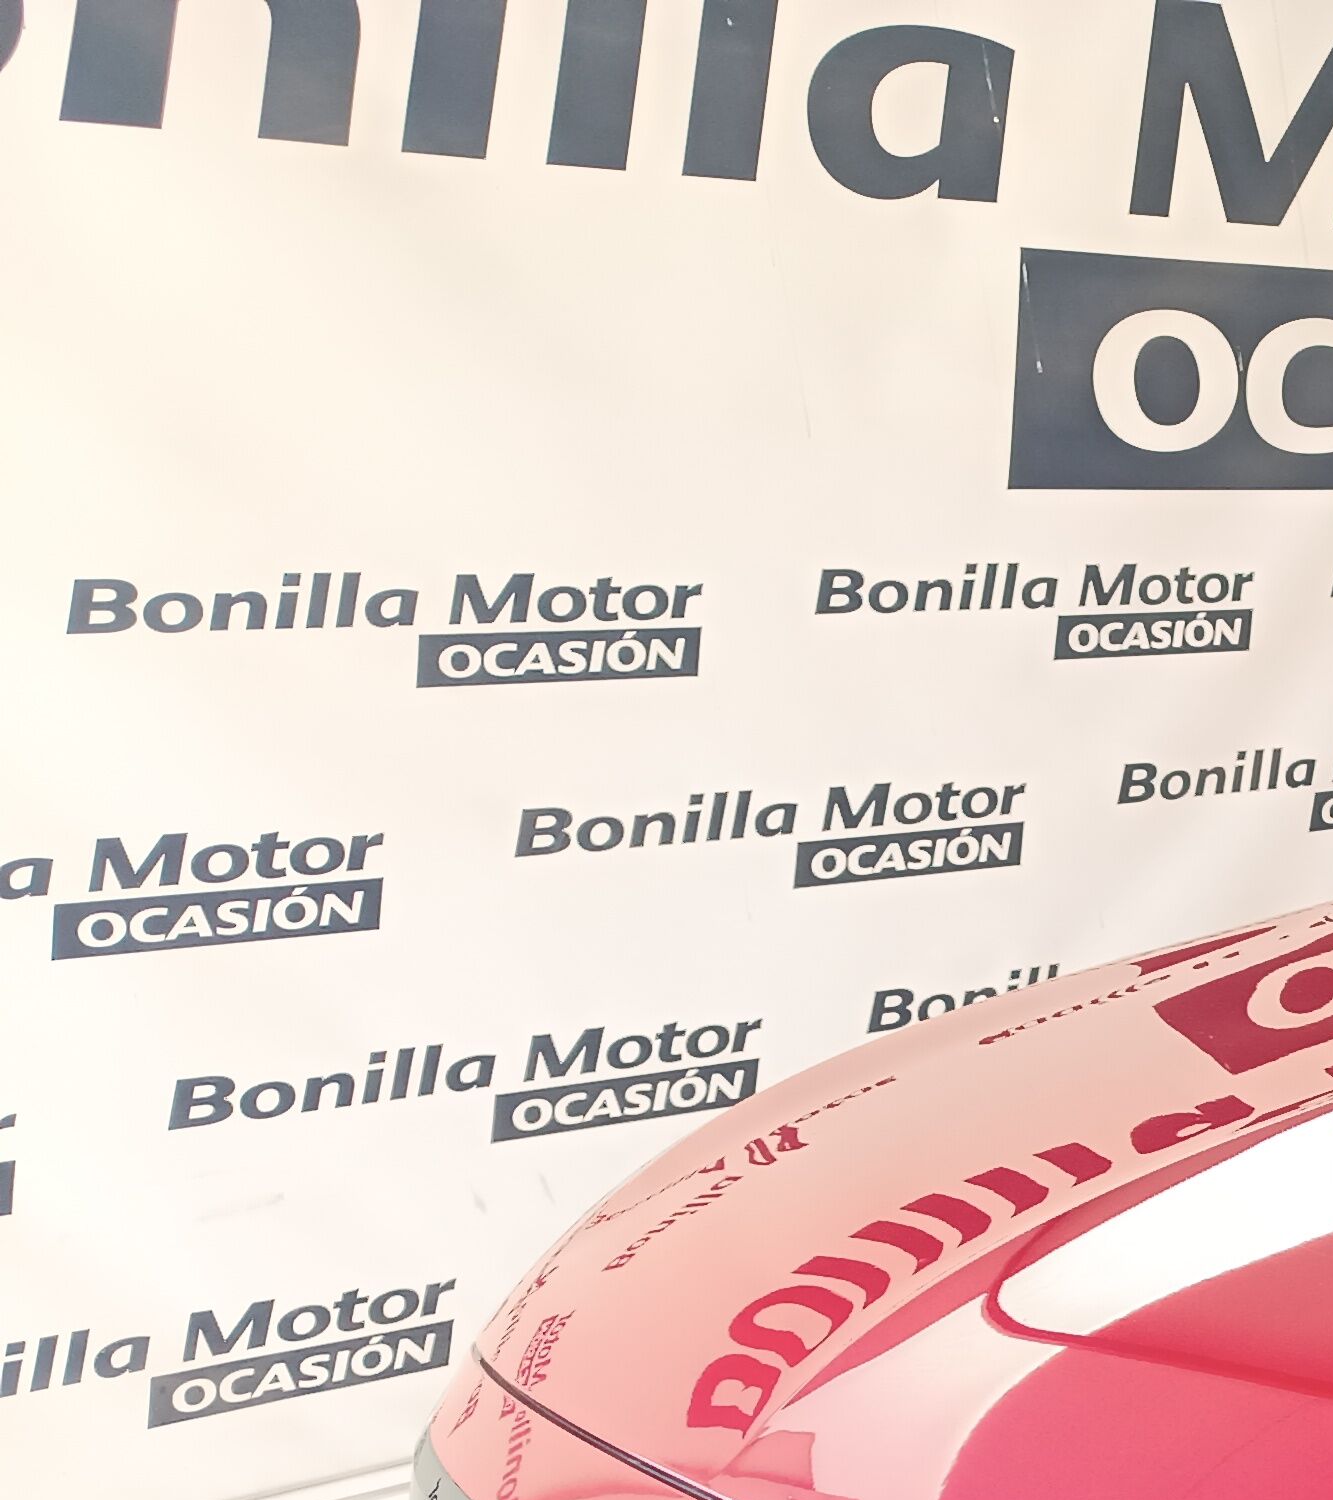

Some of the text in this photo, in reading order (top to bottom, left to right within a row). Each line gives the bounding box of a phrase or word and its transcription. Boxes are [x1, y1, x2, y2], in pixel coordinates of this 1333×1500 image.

[67, 572, 703, 634] Bonilla Motor
[815, 563, 1253, 614] Bonilla Motor
[439, 631, 685, 678] OCASIÓN
[1069, 612, 1242, 652] OCASIÓN
[1118, 748, 1316, 804] Bonilla
[515, 782, 1026, 857] Bonilla Motor
[89, 832, 384, 892] Motor
[811, 829, 1011, 879] OCASIÓN
[78, 887, 364, 947] OCASIÓN
[168, 1018, 762, 1130] Bonilla Motor
[512, 1069, 744, 1131] OCASIÓN
[183, 1279, 456, 1362] Motor
[172, 1333, 435, 1412] OCASIÓN
